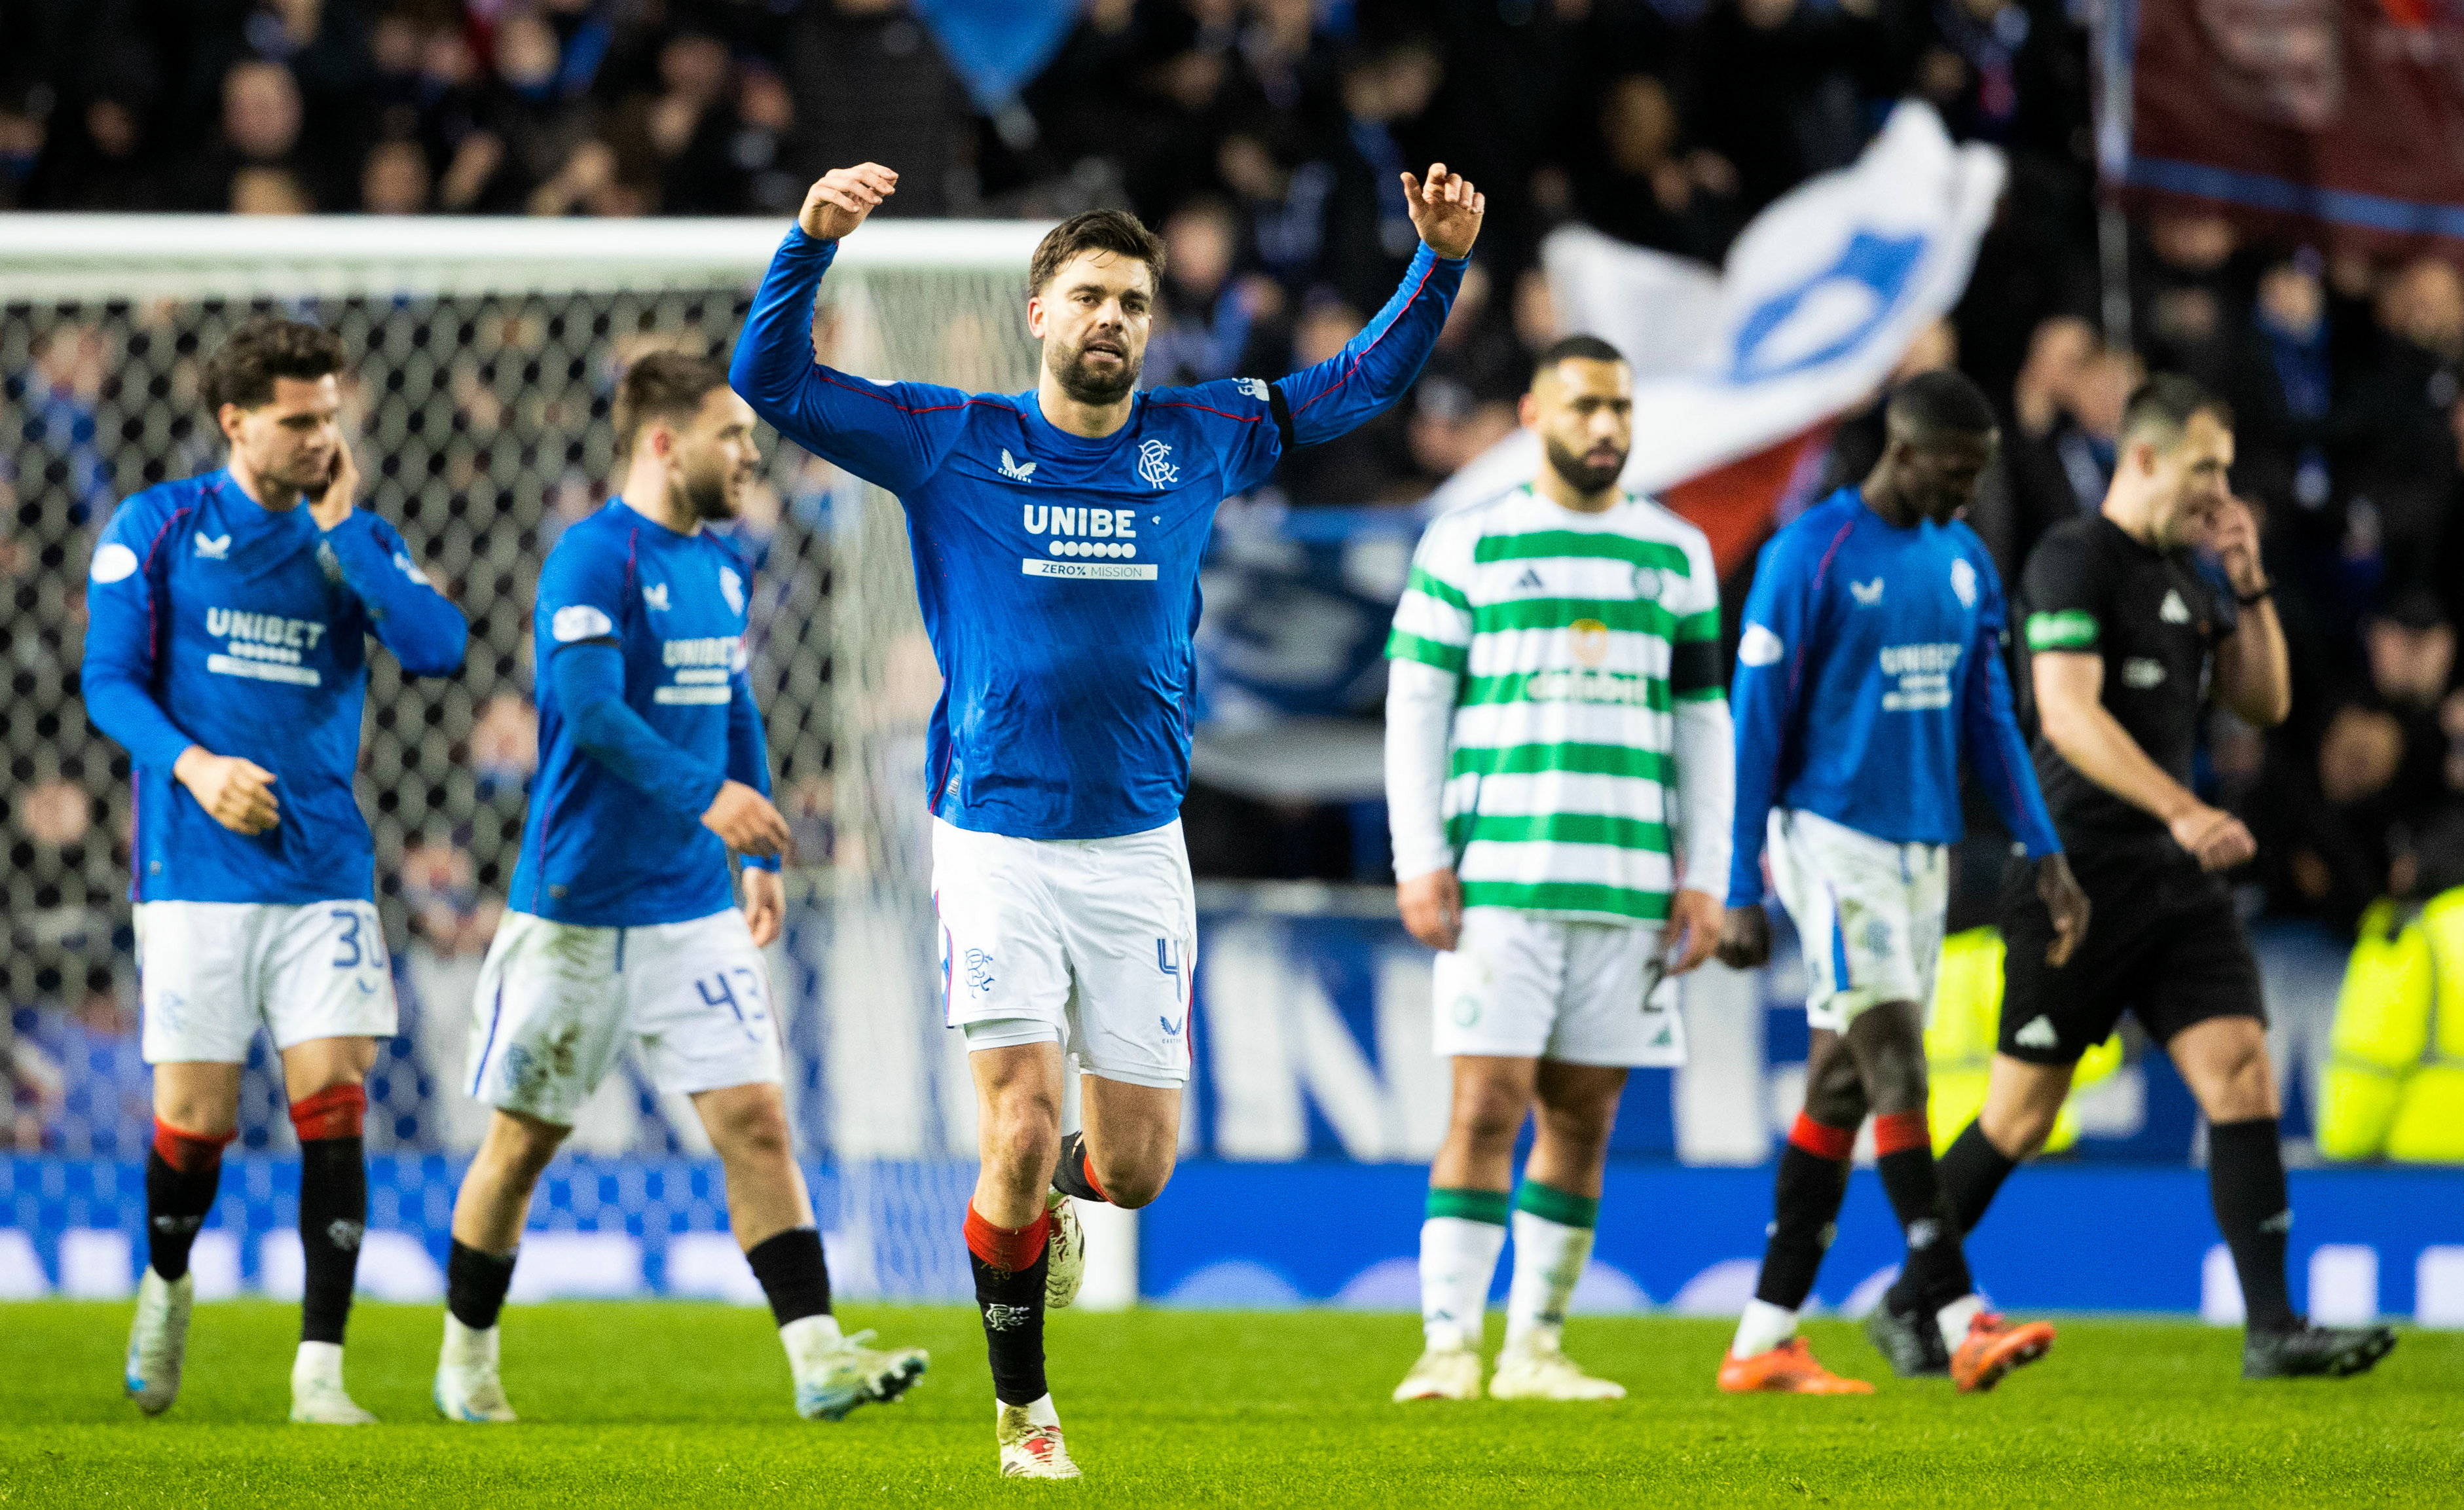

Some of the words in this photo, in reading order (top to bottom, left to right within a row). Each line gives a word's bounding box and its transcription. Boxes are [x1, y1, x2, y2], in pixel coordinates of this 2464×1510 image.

[1042, 563, 1086, 576] ZERO%
[1090, 566, 1142, 578] MISSION
[695, 967, 765, 1023] 43
[1156, 938, 1181, 1003] 4
